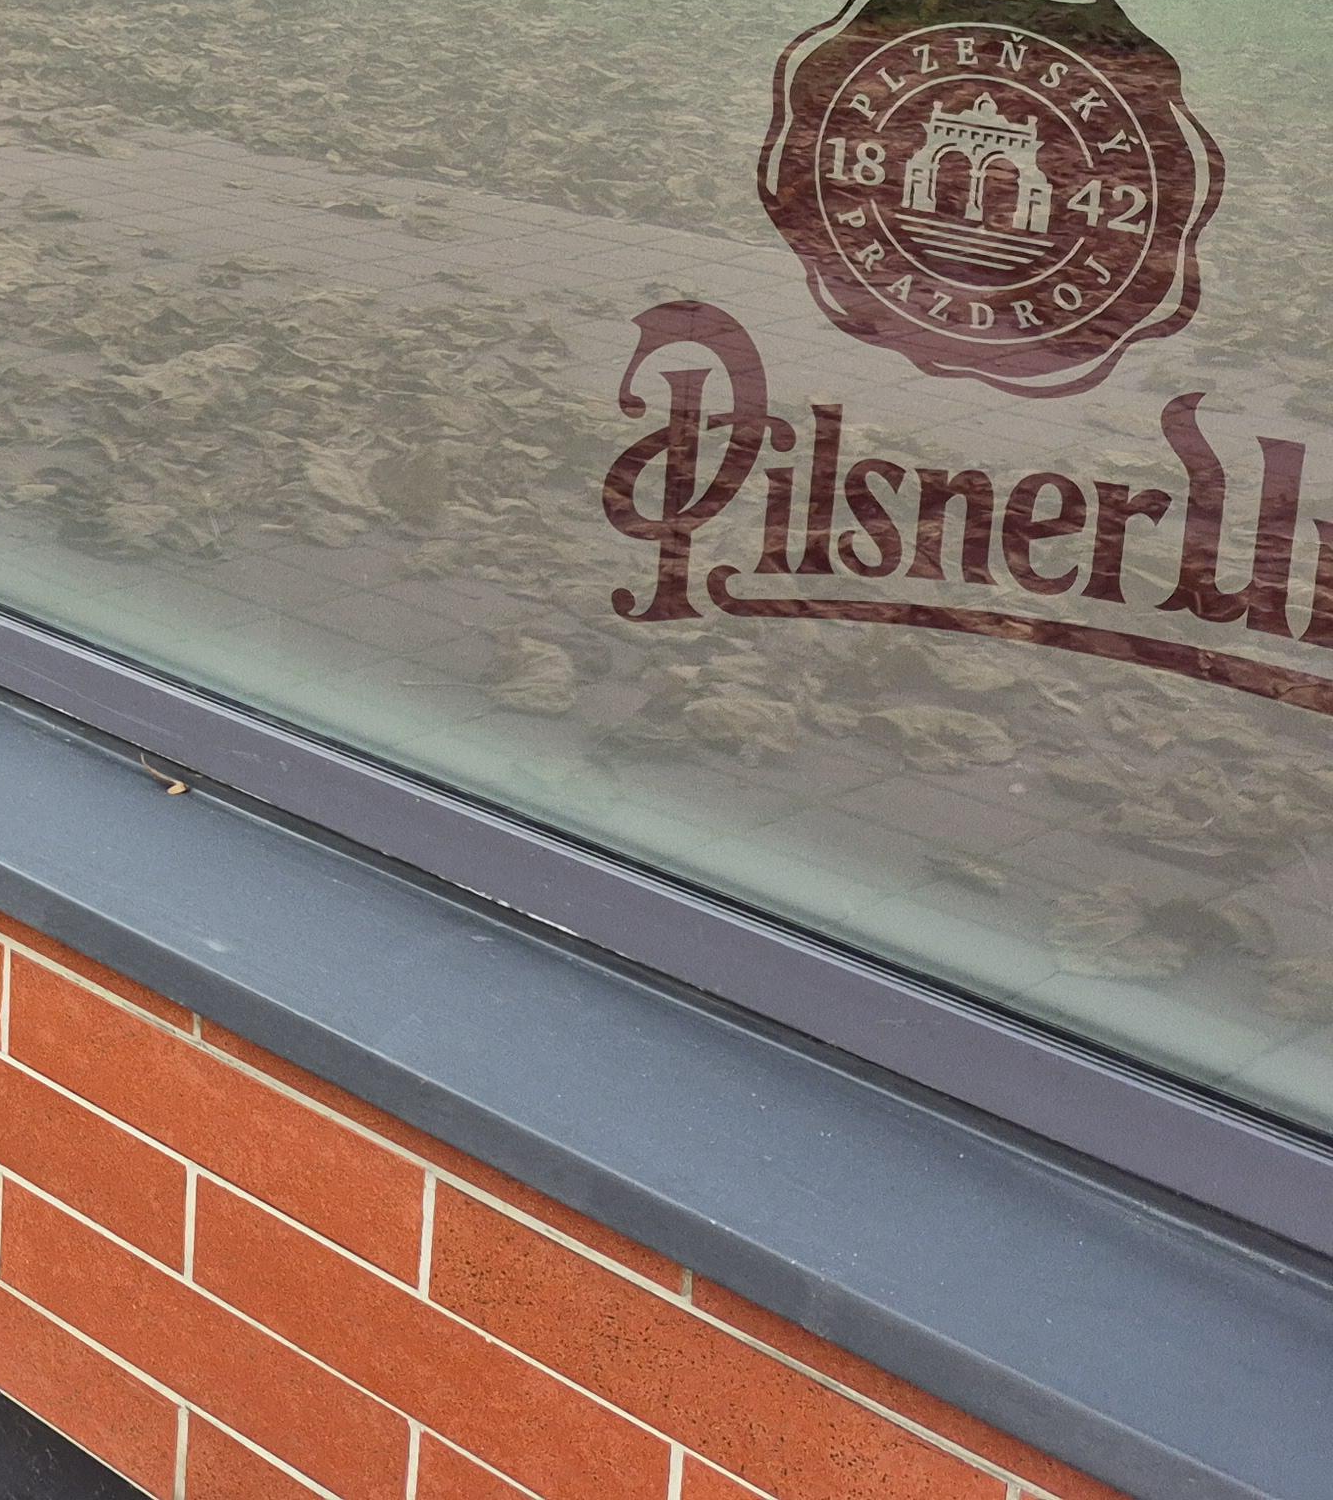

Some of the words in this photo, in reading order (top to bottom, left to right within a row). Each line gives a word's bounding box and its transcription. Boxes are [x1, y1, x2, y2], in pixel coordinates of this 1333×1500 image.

[849, 33, 1140, 156] PLZEŇSKÝ
[825, 137, 887, 187] 18
[1067, 179, 1148, 236] 42
[837, 209, 1112, 330] PRAZDROJ
